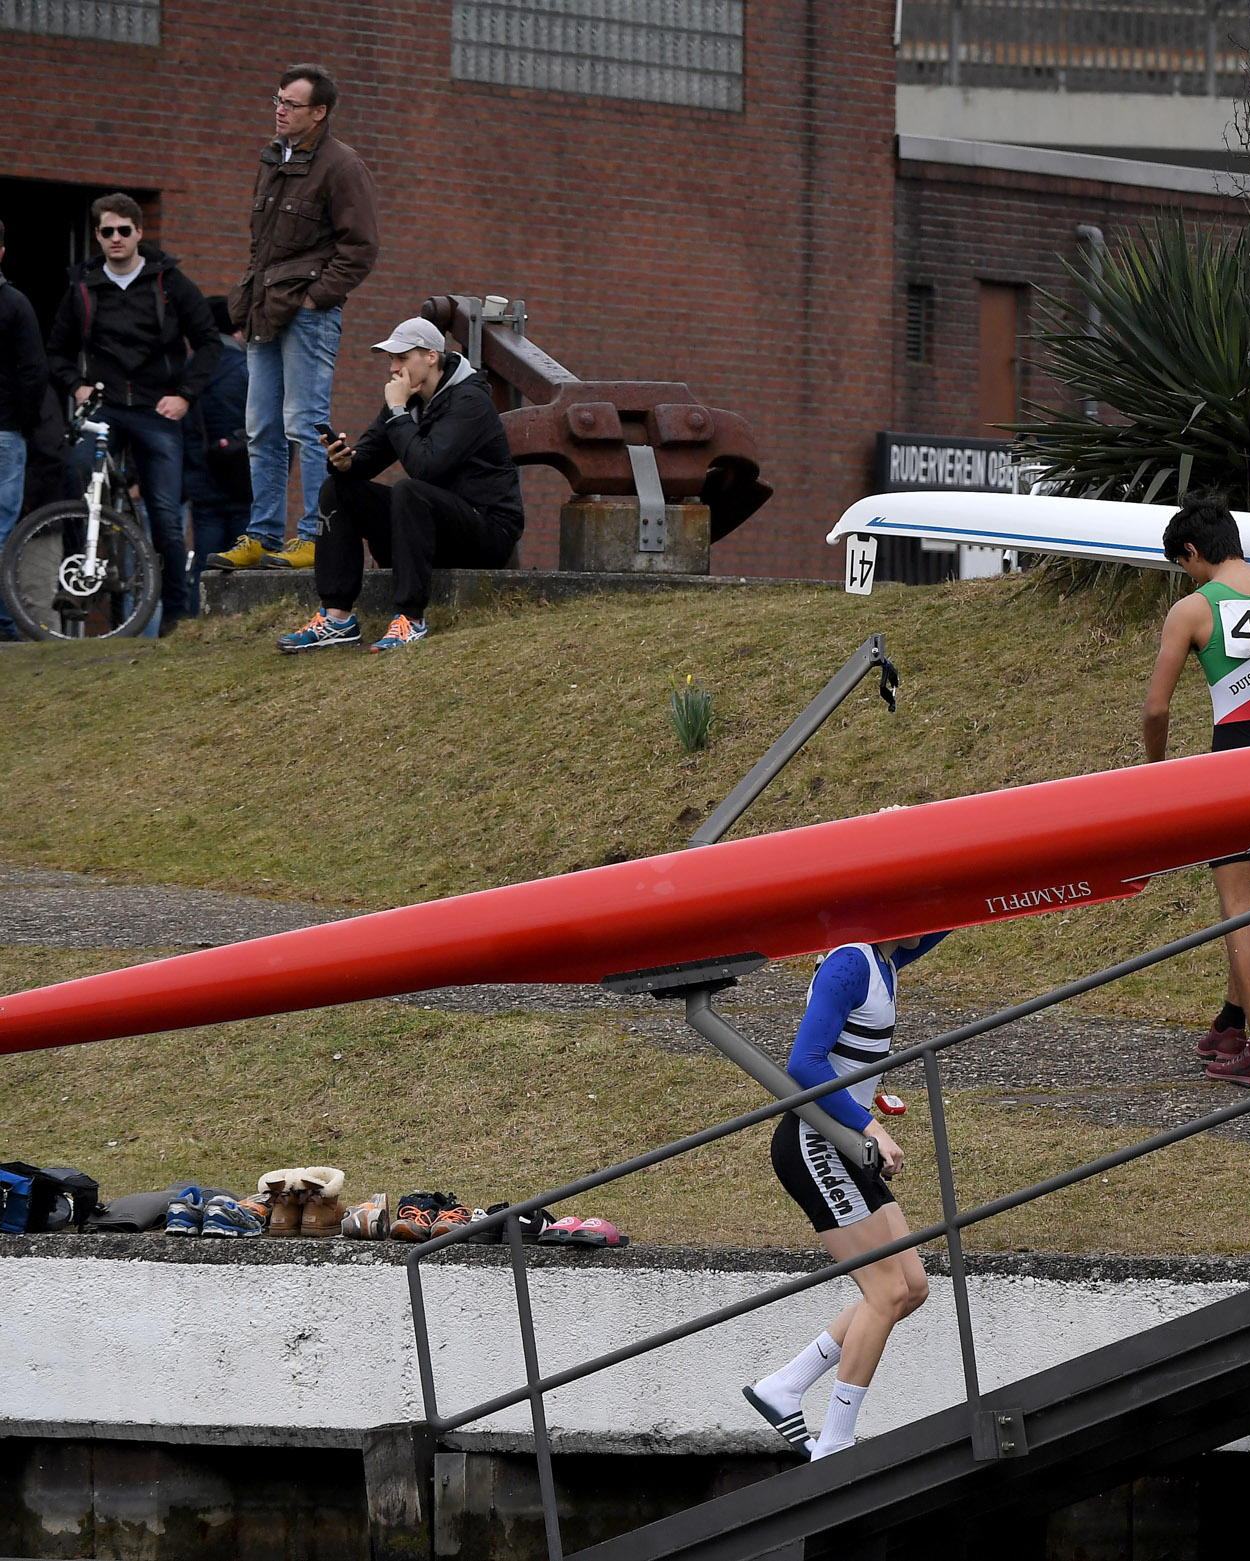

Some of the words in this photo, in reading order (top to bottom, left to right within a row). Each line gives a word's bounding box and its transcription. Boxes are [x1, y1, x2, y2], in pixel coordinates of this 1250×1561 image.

[890, 444, 987, 486] RUDERVEREIN
[849, 549, 873, 588] 41
[985, 881, 1092, 913] STÄMPFLI
[805, 1133, 853, 1216] Minden
